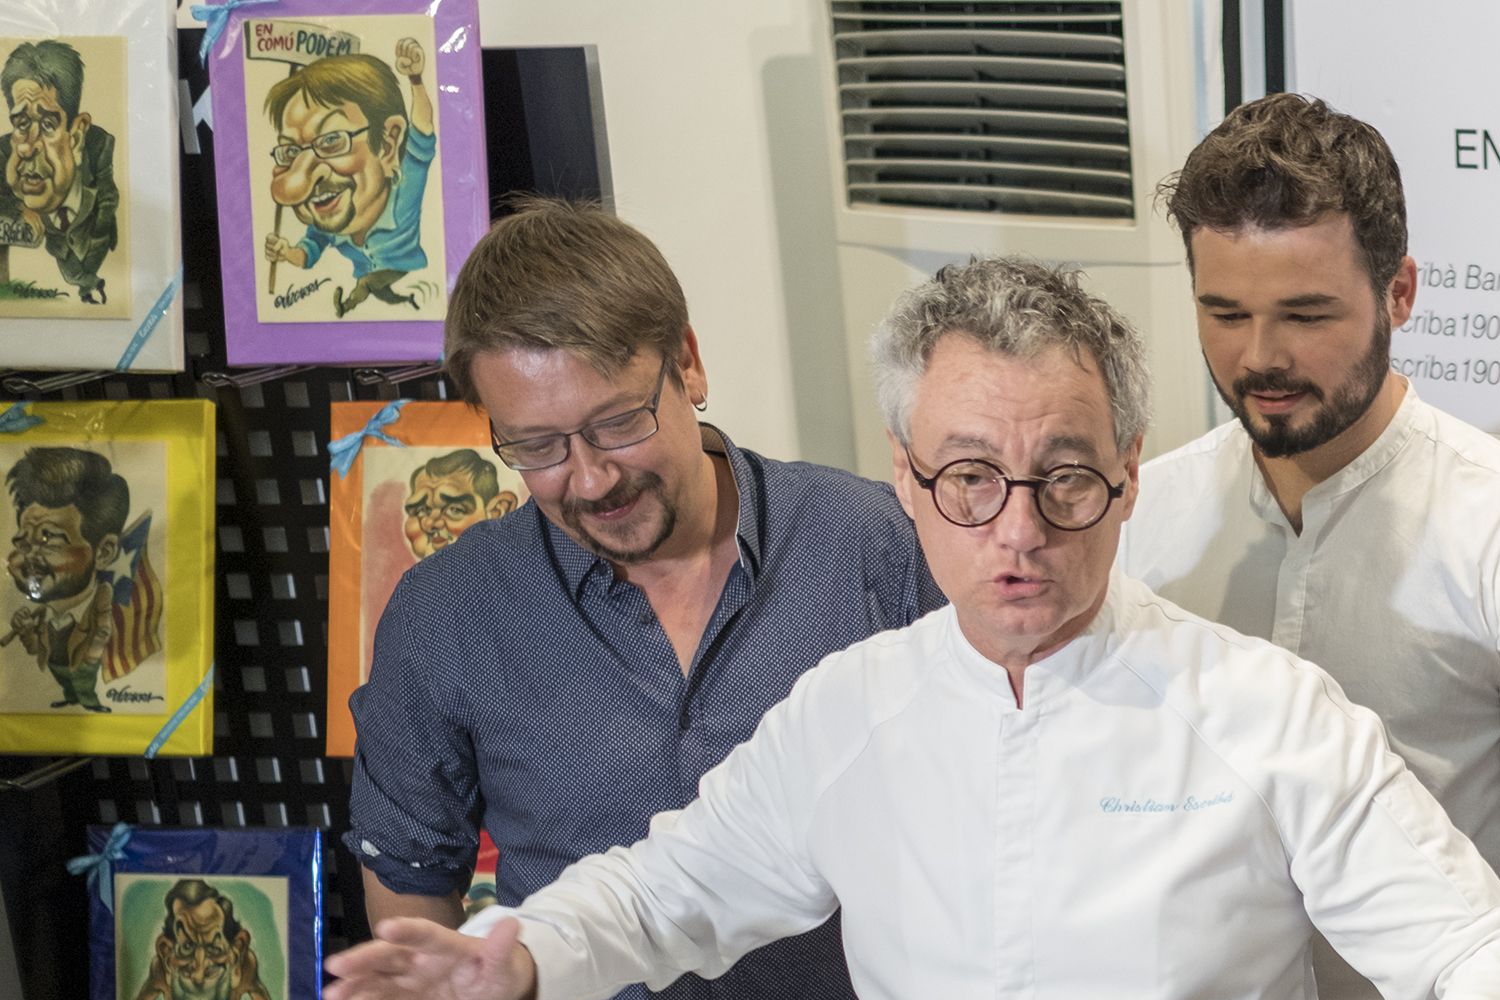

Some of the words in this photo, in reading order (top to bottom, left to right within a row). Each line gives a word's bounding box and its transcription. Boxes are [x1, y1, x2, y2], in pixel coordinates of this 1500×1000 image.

[255, 23, 274, 37] EN
[257, 32, 295, 52] COMÚ
[295, 29, 353, 57] PODEM
